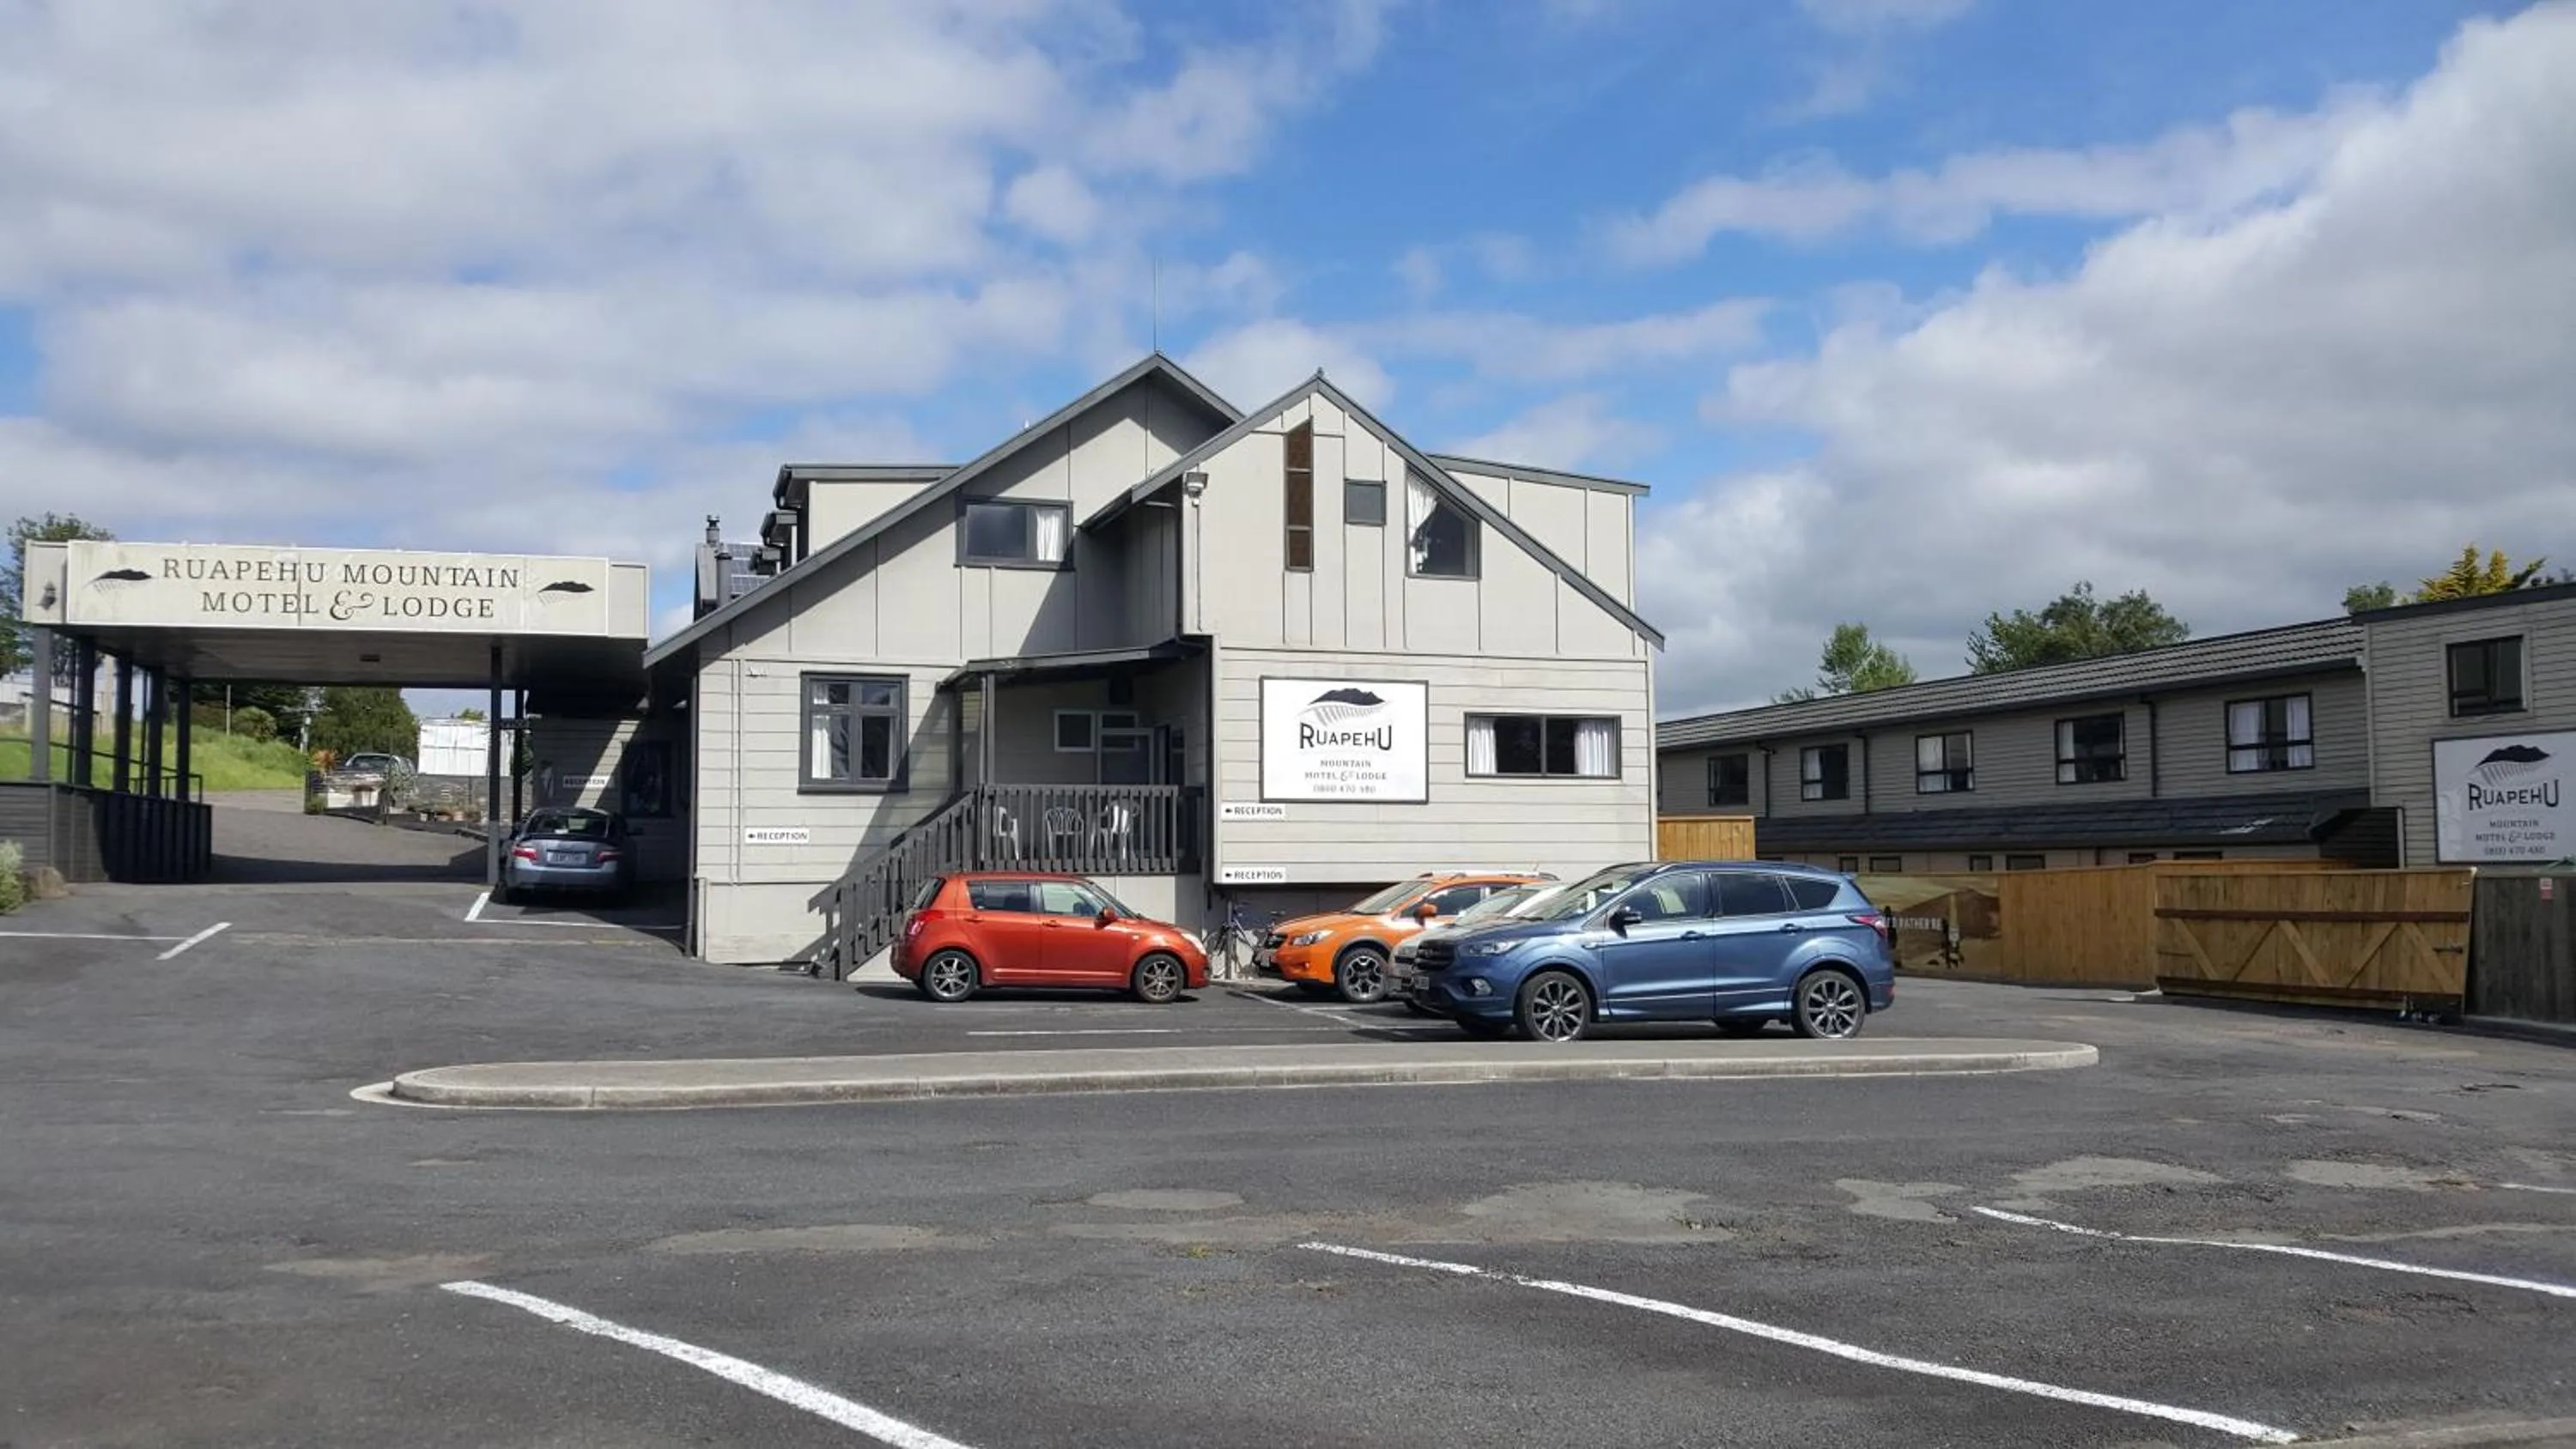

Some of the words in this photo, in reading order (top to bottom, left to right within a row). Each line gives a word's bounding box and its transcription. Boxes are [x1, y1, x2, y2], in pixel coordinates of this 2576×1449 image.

[162, 558, 325, 583] RUAPEHU
[343, 563, 519, 588] MOUNTAIN
[201, 591, 319, 614] MOTEL
[329, 590, 375, 621] &
[383, 597, 495, 619] LODGE
[1320, 759, 1372, 768] MOUNTAIN
[1304, 772, 1339, 780] MOTEL
[1356, 772, 1388, 780] LODGE
[1234, 806, 1283, 815] RECEPTION
[2489, 819, 2540, 829] MOUNTAIN
[756, 831, 808, 841] RECEPTION
[2475, 833, 2505, 842] MOTEL
[2524, 831, 2555, 841] LODGE
[1234, 870, 1283, 880] RECEPTION
